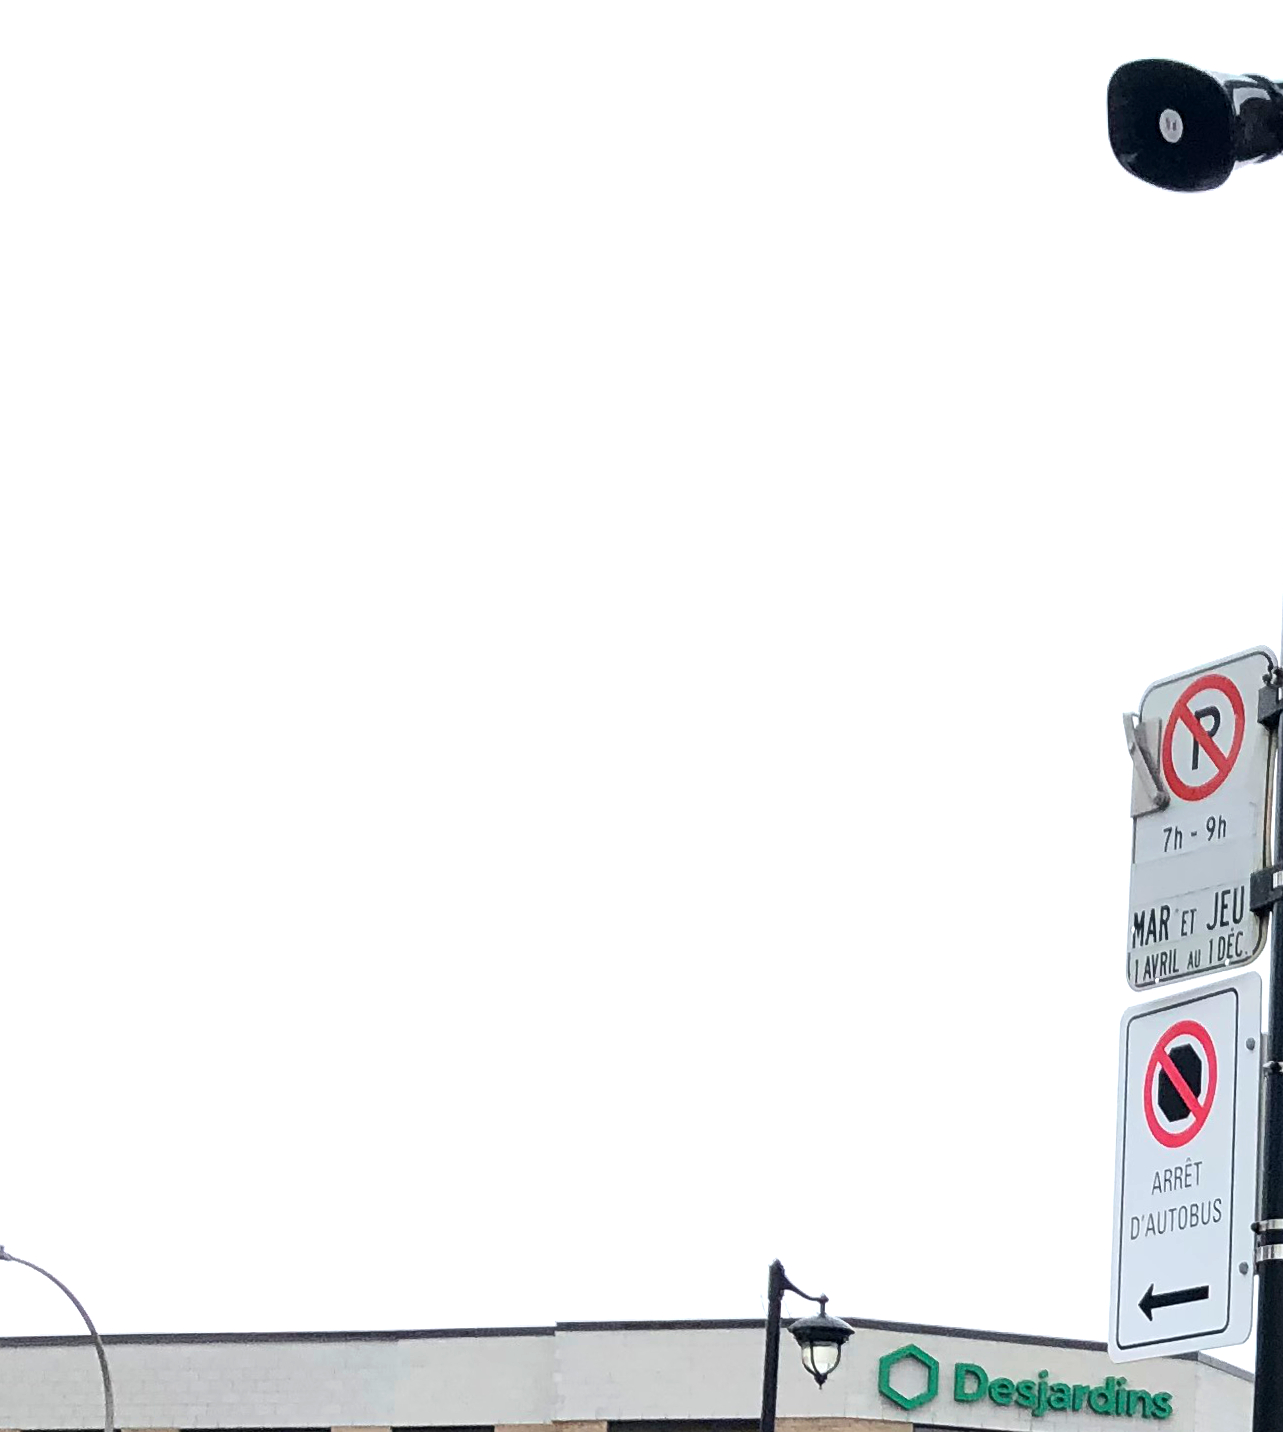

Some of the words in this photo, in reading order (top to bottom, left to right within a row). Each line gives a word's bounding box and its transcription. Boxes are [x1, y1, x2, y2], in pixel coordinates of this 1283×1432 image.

[1163, 825, 1183, 852] 7h
[1206, 815, 1227, 841] 9h
[1131, 904, 1171, 949] MAR
[1181, 908, 1197, 937] ET
[1206, 885, 1245, 931] JEU
[1143, 951, 1180, 980] AVRIL
[1187, 949, 1201, 970] AU
[1209, 938, 1214, 964] 1
[1151, 1158, 1203, 1195] ARRÊT
[1130, 1198, 1223, 1241] D'AUTOBUS
[954, 1362, 1173, 1420] Desjardins
